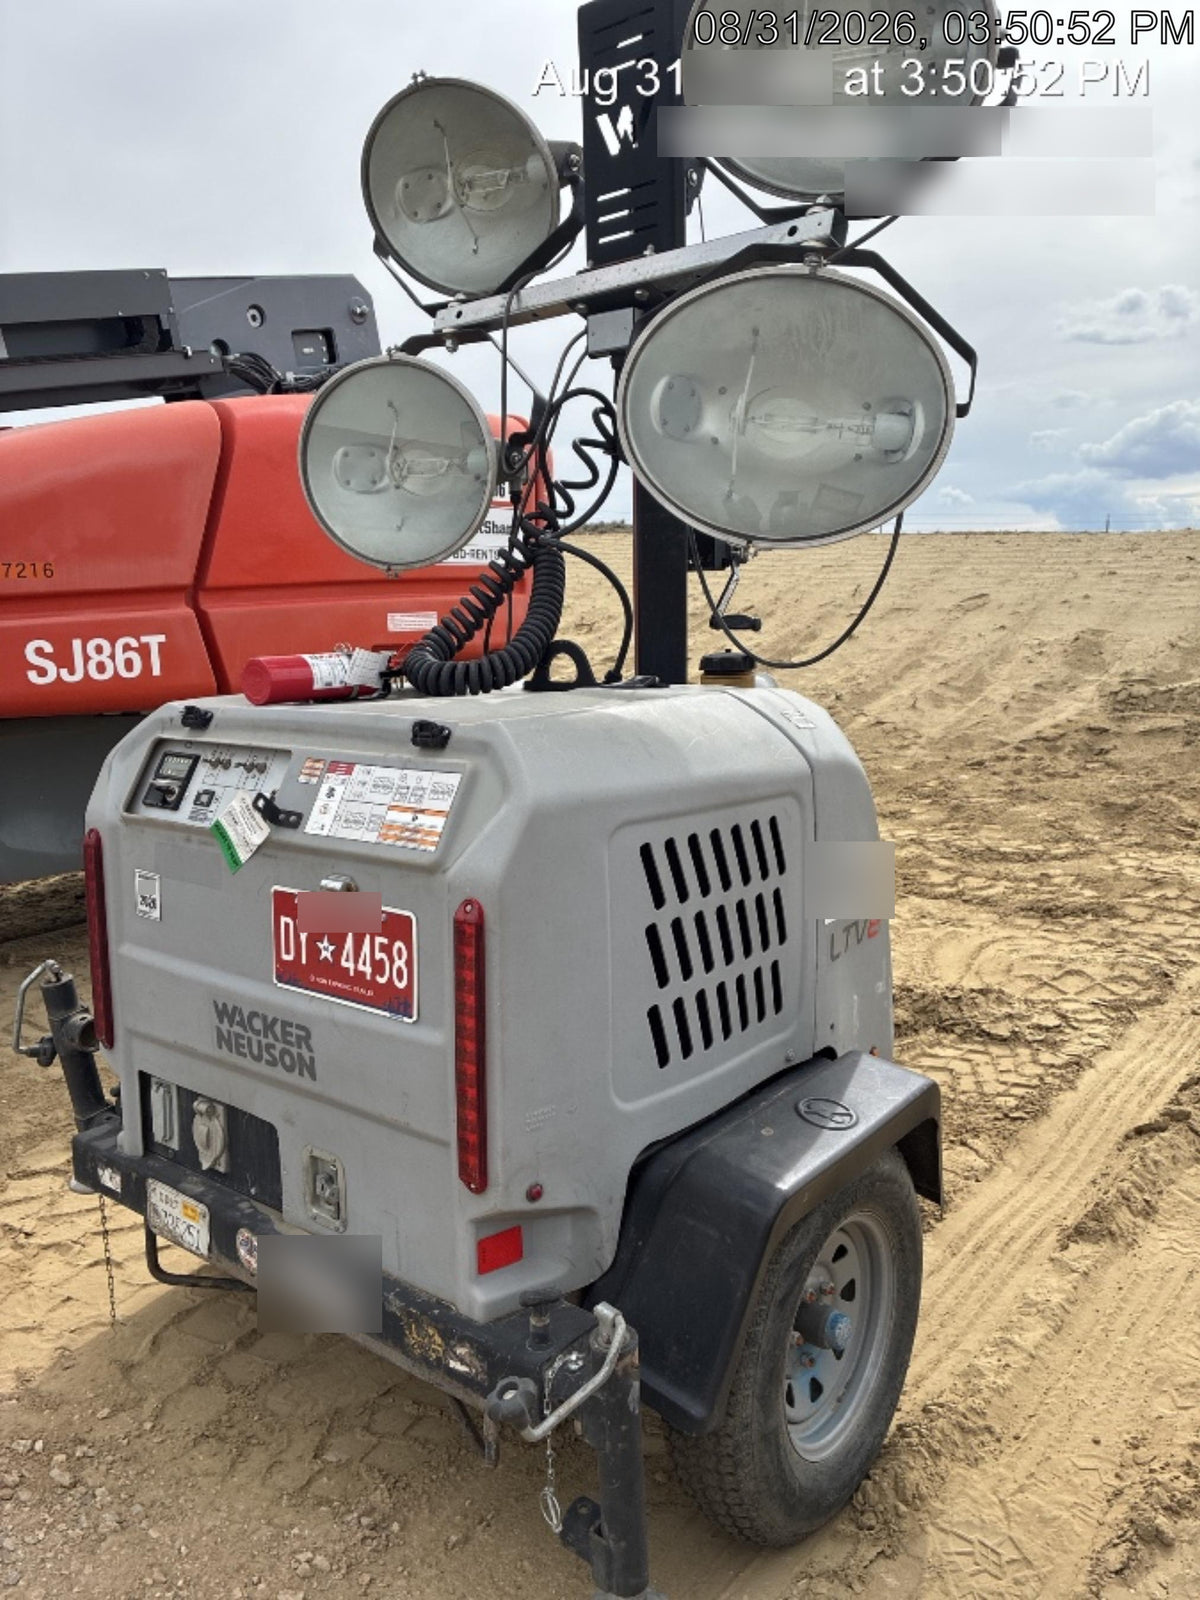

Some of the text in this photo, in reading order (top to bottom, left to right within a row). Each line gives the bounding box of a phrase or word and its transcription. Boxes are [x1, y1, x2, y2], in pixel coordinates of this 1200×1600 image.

[1, 562, 55, 579] 7216
[24, 633, 167, 686] SJ86T
[340, 931, 408, 990] 4458
[213, 998, 314, 1053] WACKER
[215, 1025, 317, 1082] NEUSON
